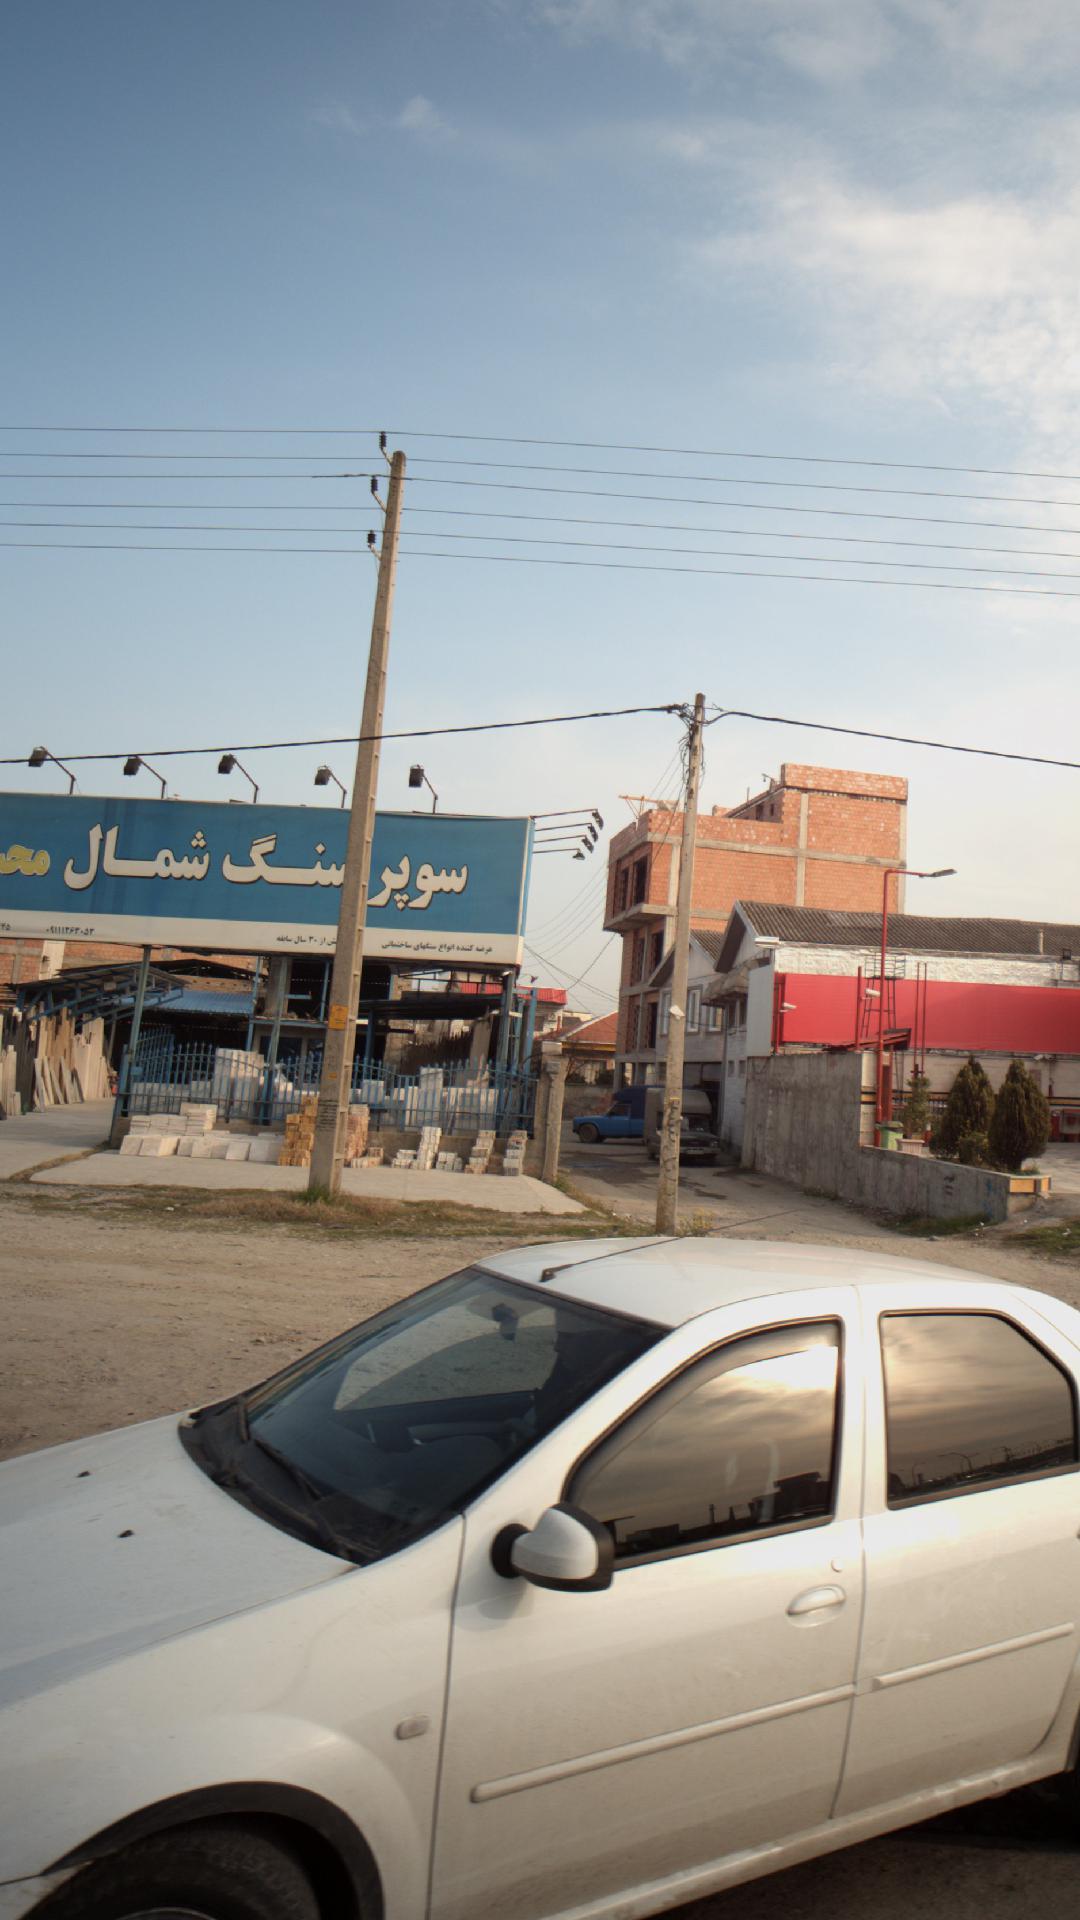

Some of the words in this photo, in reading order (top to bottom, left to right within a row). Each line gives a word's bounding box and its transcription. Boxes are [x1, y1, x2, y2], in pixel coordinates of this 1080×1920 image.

[64, 823, 210, 891] شمال
[366, 855, 468, 911] سوپر
[294, 935, 307, 945] سال
[438, 943, 455, 953] انواع
[455, 944, 474, 952] کننده
